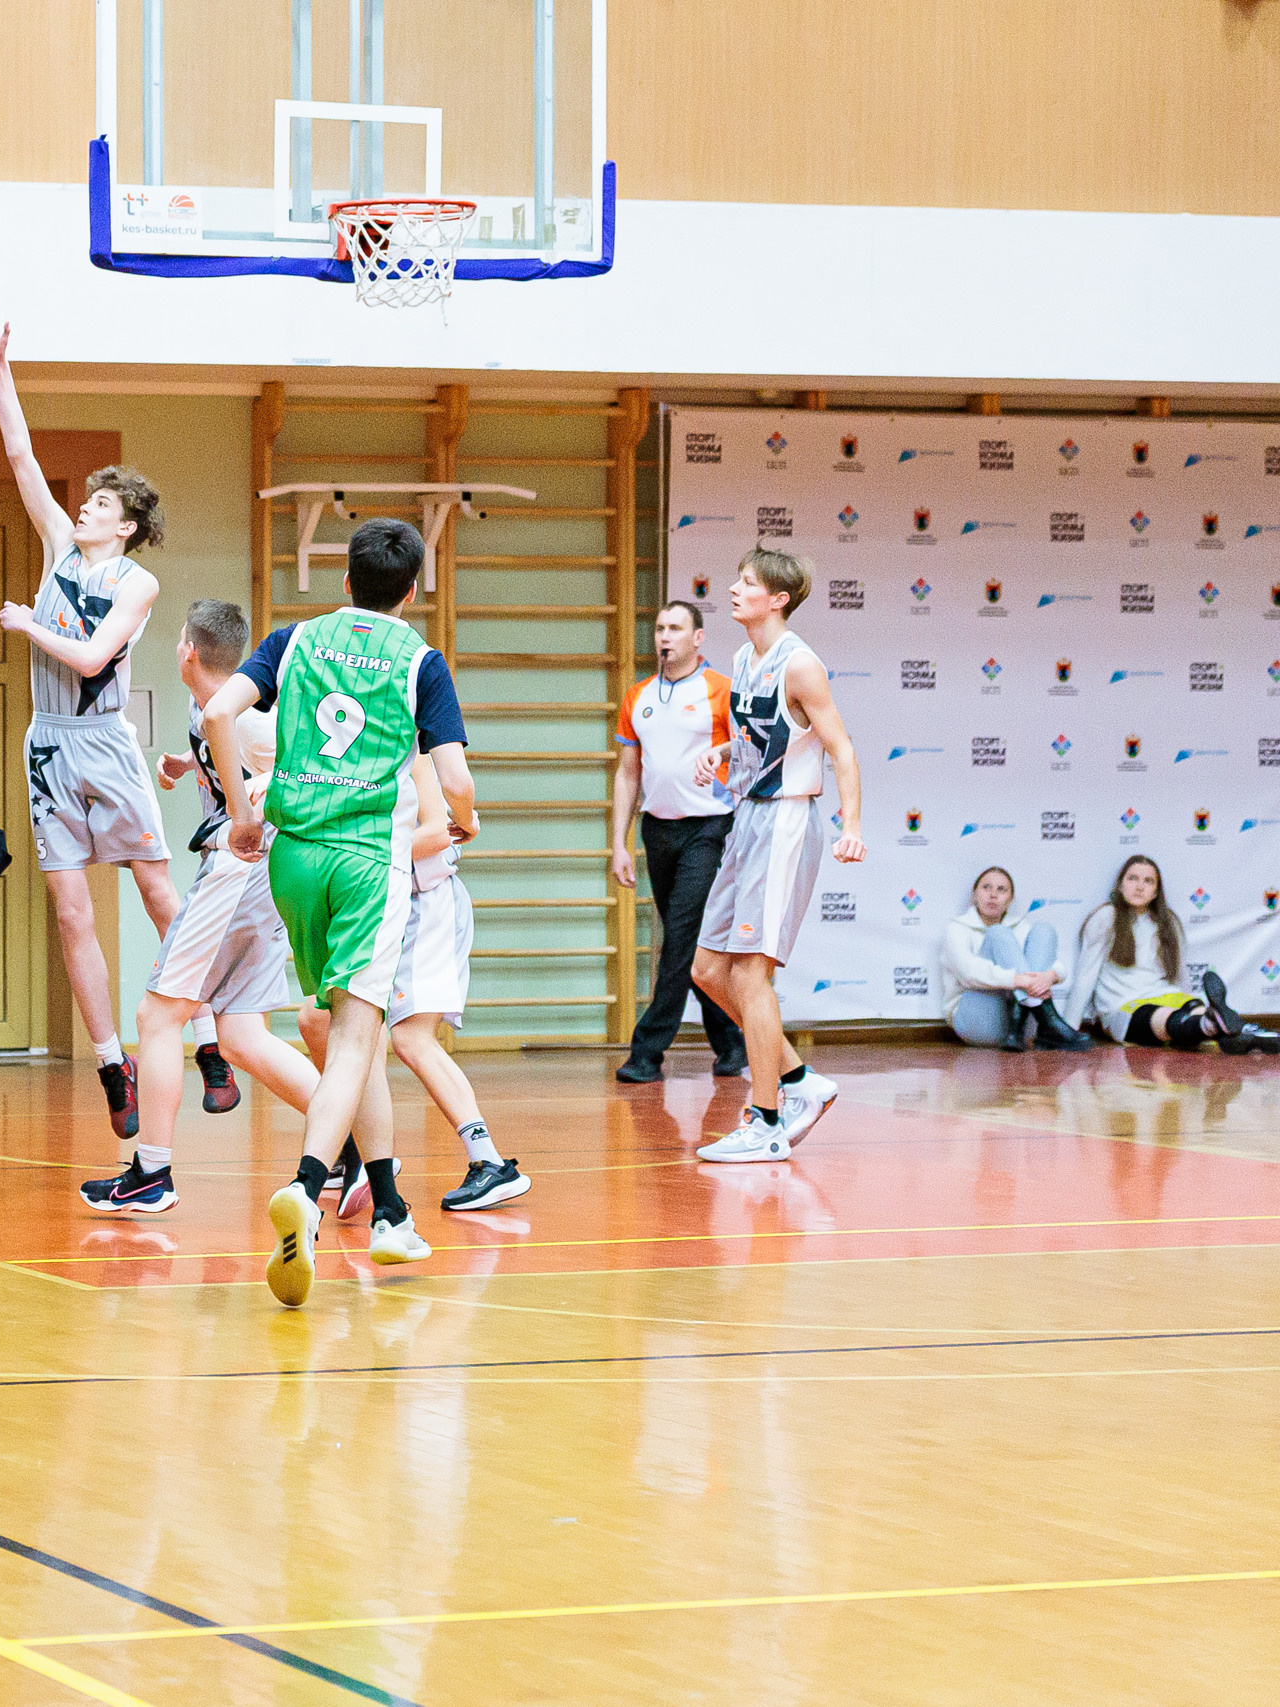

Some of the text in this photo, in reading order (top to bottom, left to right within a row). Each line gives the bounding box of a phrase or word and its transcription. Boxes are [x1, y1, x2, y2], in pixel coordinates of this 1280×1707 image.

[122, 224, 197, 235] kes-basket.ru
[314, 646, 392, 672] КАРЕЛИЯ
[736, 691, 753, 714] 11
[315, 691, 367, 760] 9
[297, 773, 325, 784] ОДНА
[36, 838, 48, 861] 5
